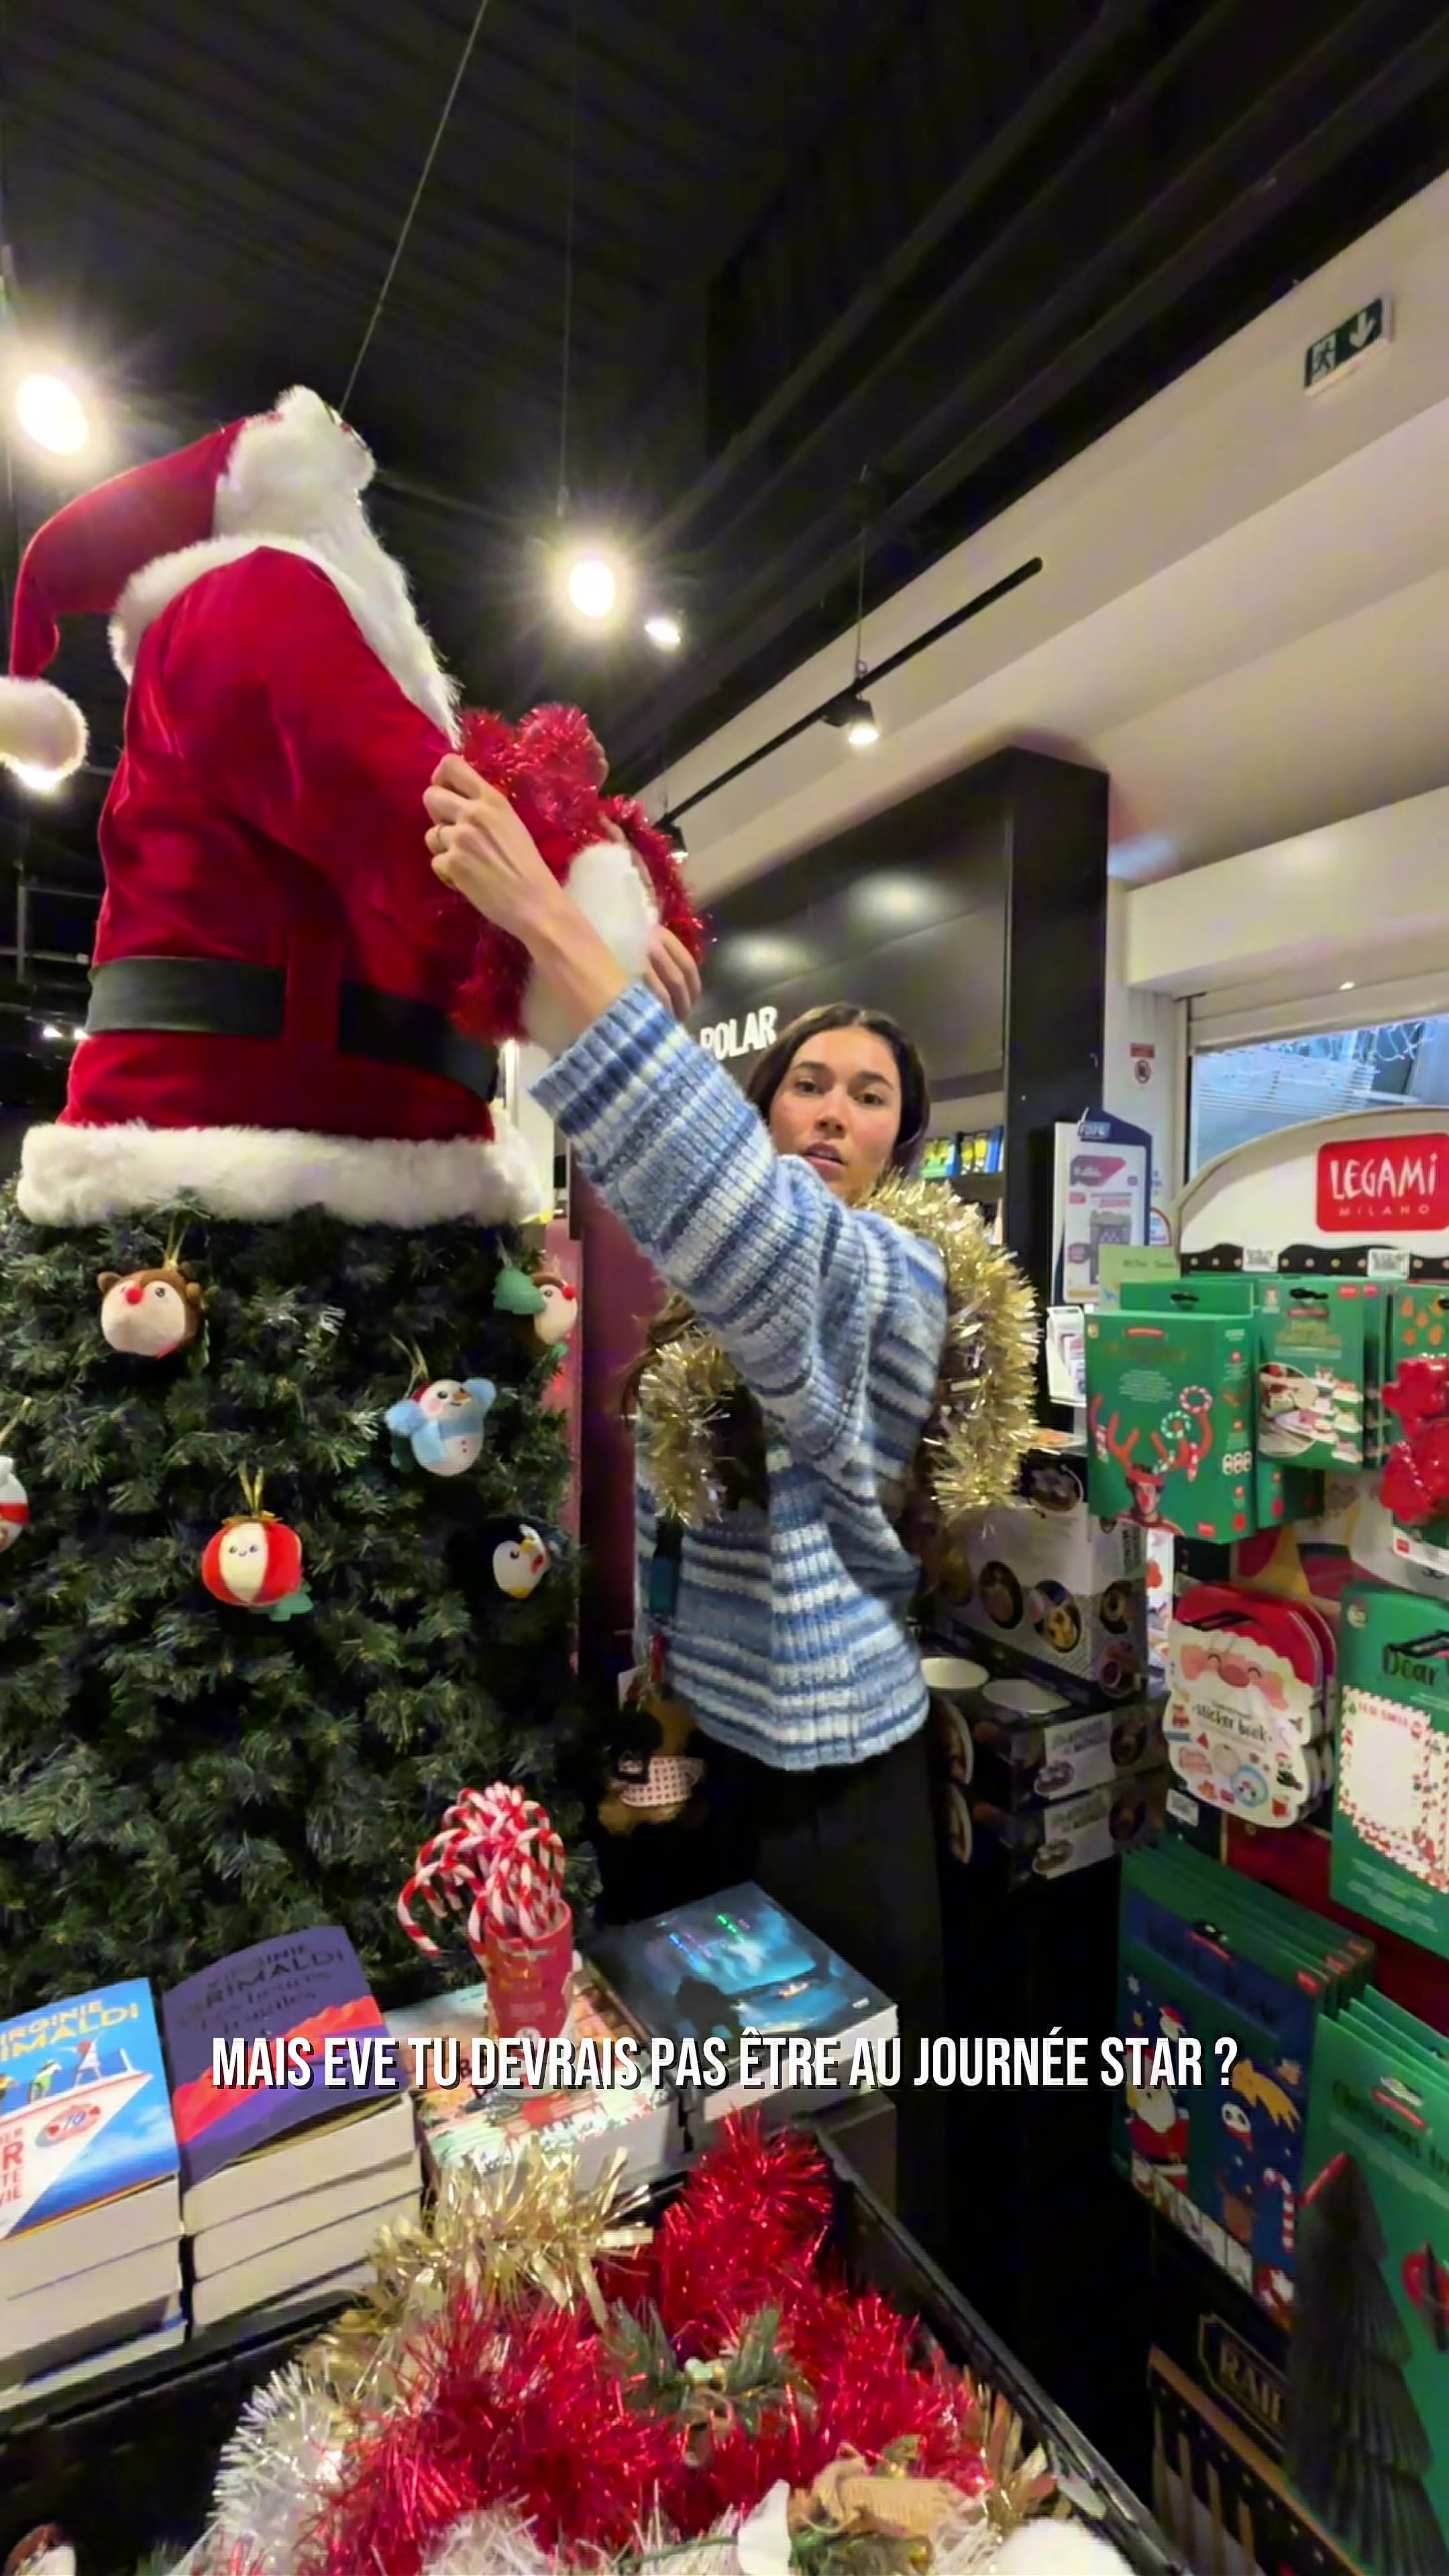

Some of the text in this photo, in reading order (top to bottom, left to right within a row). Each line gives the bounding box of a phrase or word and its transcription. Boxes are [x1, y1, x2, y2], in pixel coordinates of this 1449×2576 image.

[700, 1005, 777, 1061] POLAR
[1339, 1204, 1430, 1216] MILANO
[193, 1948, 344, 2015] RIMALDI
